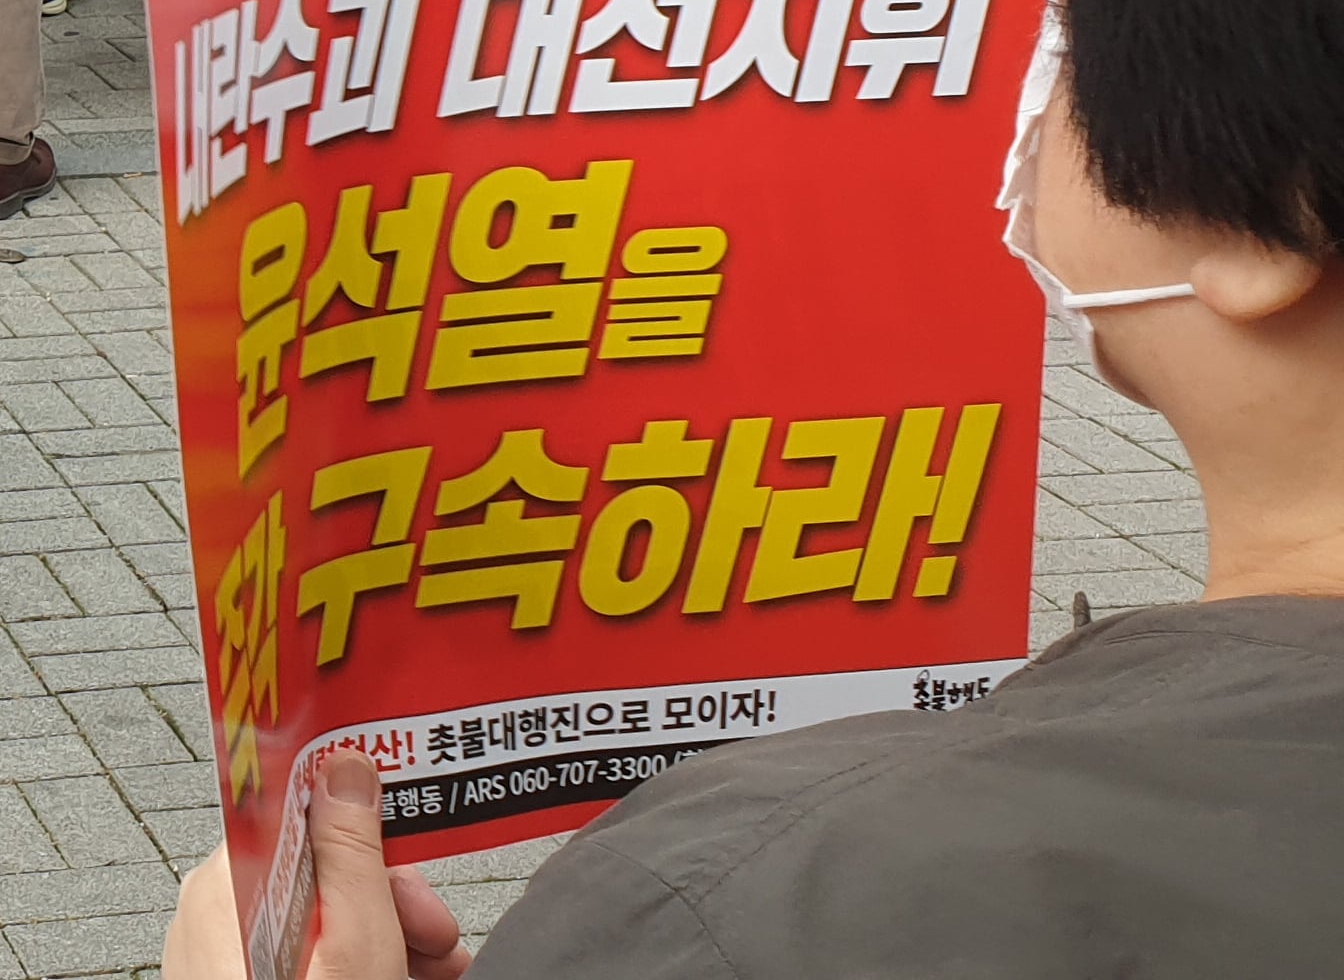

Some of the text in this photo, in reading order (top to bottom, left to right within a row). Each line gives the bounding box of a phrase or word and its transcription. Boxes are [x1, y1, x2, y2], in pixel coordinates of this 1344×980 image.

[237, 158, 730, 480] 윤석열을
[296, 403, 1004, 668] 구속하라!
[379, 788, 444, 820] 불행동
[462, 772, 506, 806] ARS
[510, 753, 668, 795] 060-707-3300
[426, 700, 651, 766] 촛불대행진으로
[660, 688, 778, 733] 모이자!
